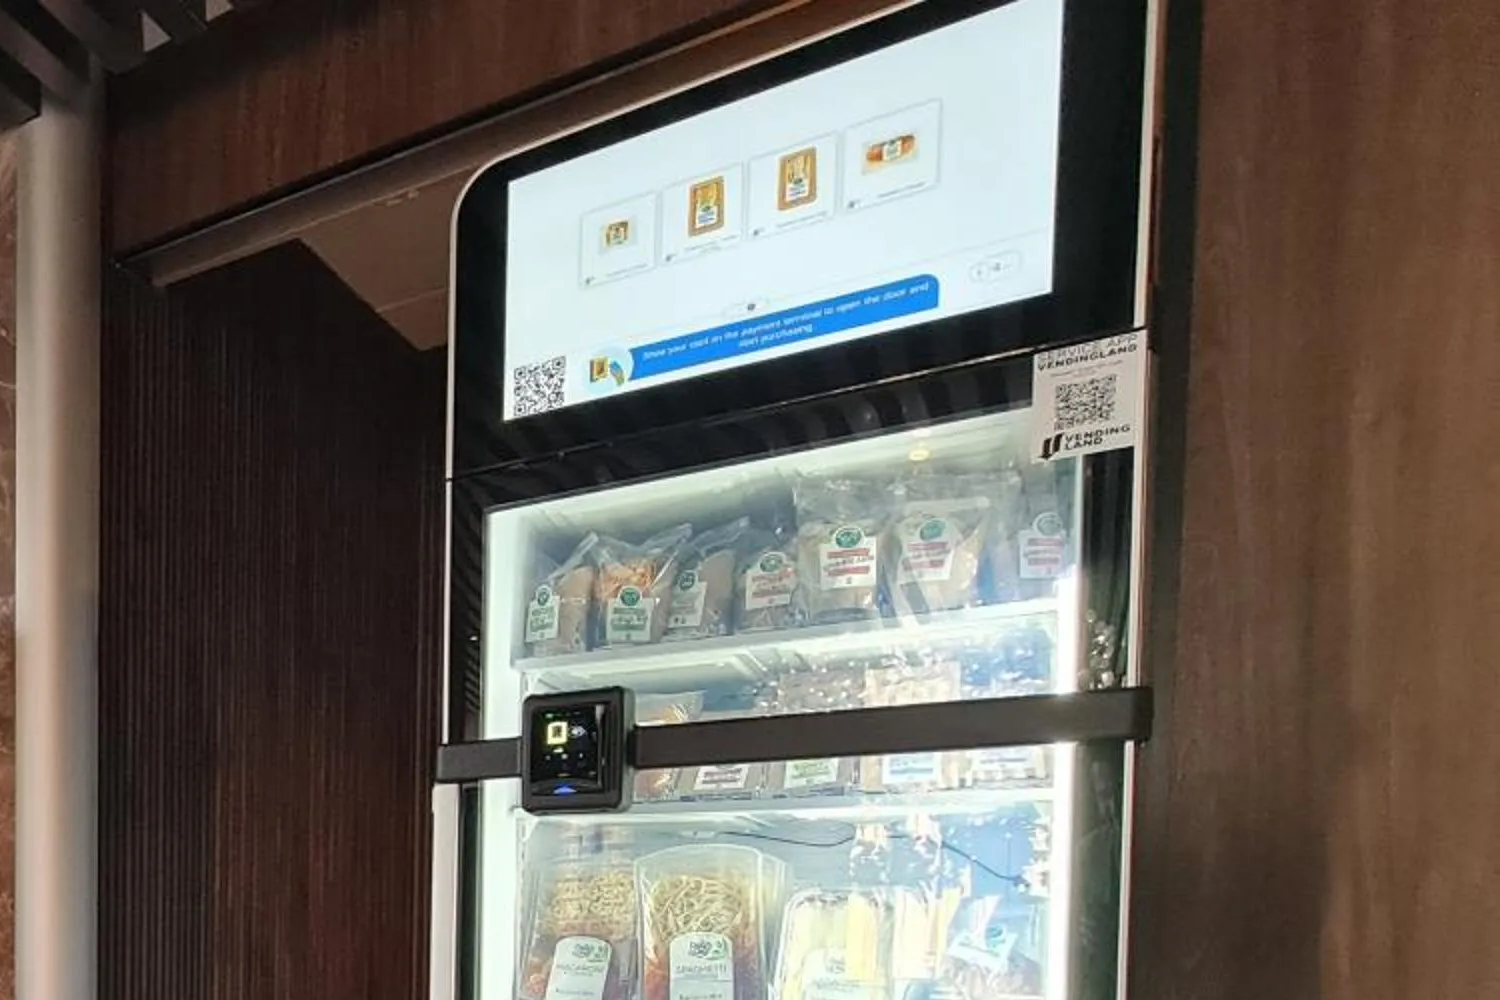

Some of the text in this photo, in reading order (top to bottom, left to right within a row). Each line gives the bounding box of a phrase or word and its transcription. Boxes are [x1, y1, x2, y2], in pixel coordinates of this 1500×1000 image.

[740, 319, 781, 338] payment
[783, 308, 822, 325] terminal
[836, 299, 861, 315] open
[863, 294, 880, 306] the
[883, 287, 906, 301] door
[909, 281, 929, 295] and
[760, 322, 813, 345] purchasing
[1038, 343, 1138, 371] VENDINGLAND
[1064, 437, 1104, 451] LAND
[1065, 424, 1131, 442] VENDING
